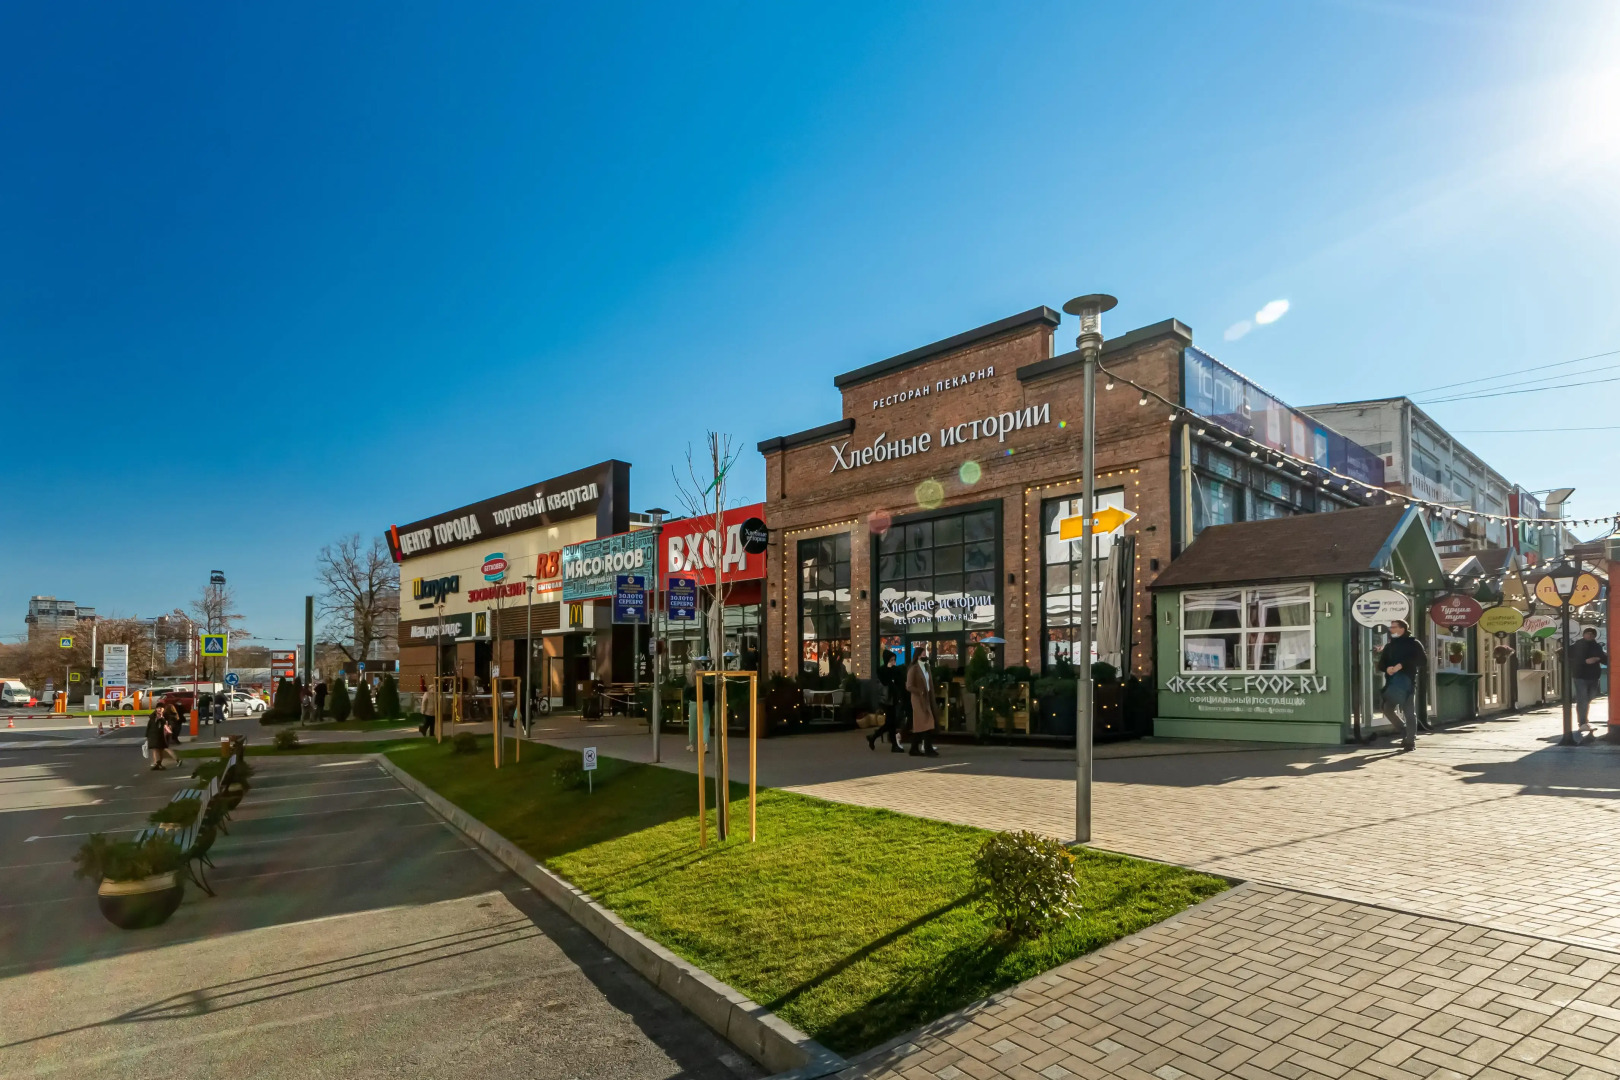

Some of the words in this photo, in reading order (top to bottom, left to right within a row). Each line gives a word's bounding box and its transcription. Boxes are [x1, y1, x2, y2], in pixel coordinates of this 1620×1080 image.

[873, 385, 931, 410] РЕСТОРАН
[936, 366, 995, 392] ПЕКАРНЯ
[829, 432, 931, 473] Хлебные
[940, 403, 1050, 447] истории
[492, 496, 547, 527] торговый
[547, 483, 599, 511] квартал
[399, 528, 432, 555] ЦЕНТР
[433, 514, 482, 545] ГОРОДА
[668, 523, 747, 573] ВХОД
[412, 574, 459, 604] Шатура
[468, 582, 526, 603] ЗООМАГАЗИН
[882, 597, 935, 613] Хлебные
[940, 595, 991, 611] истории
[893, 616, 932, 625] РЕСТОРАН
[1440, 605, 1471, 614] Турция
[1189, 696, 1252, 705] ОФИЦИАЛЬНЫЙ
[1252, 697, 1306, 706] ПОСТАВЩИК
